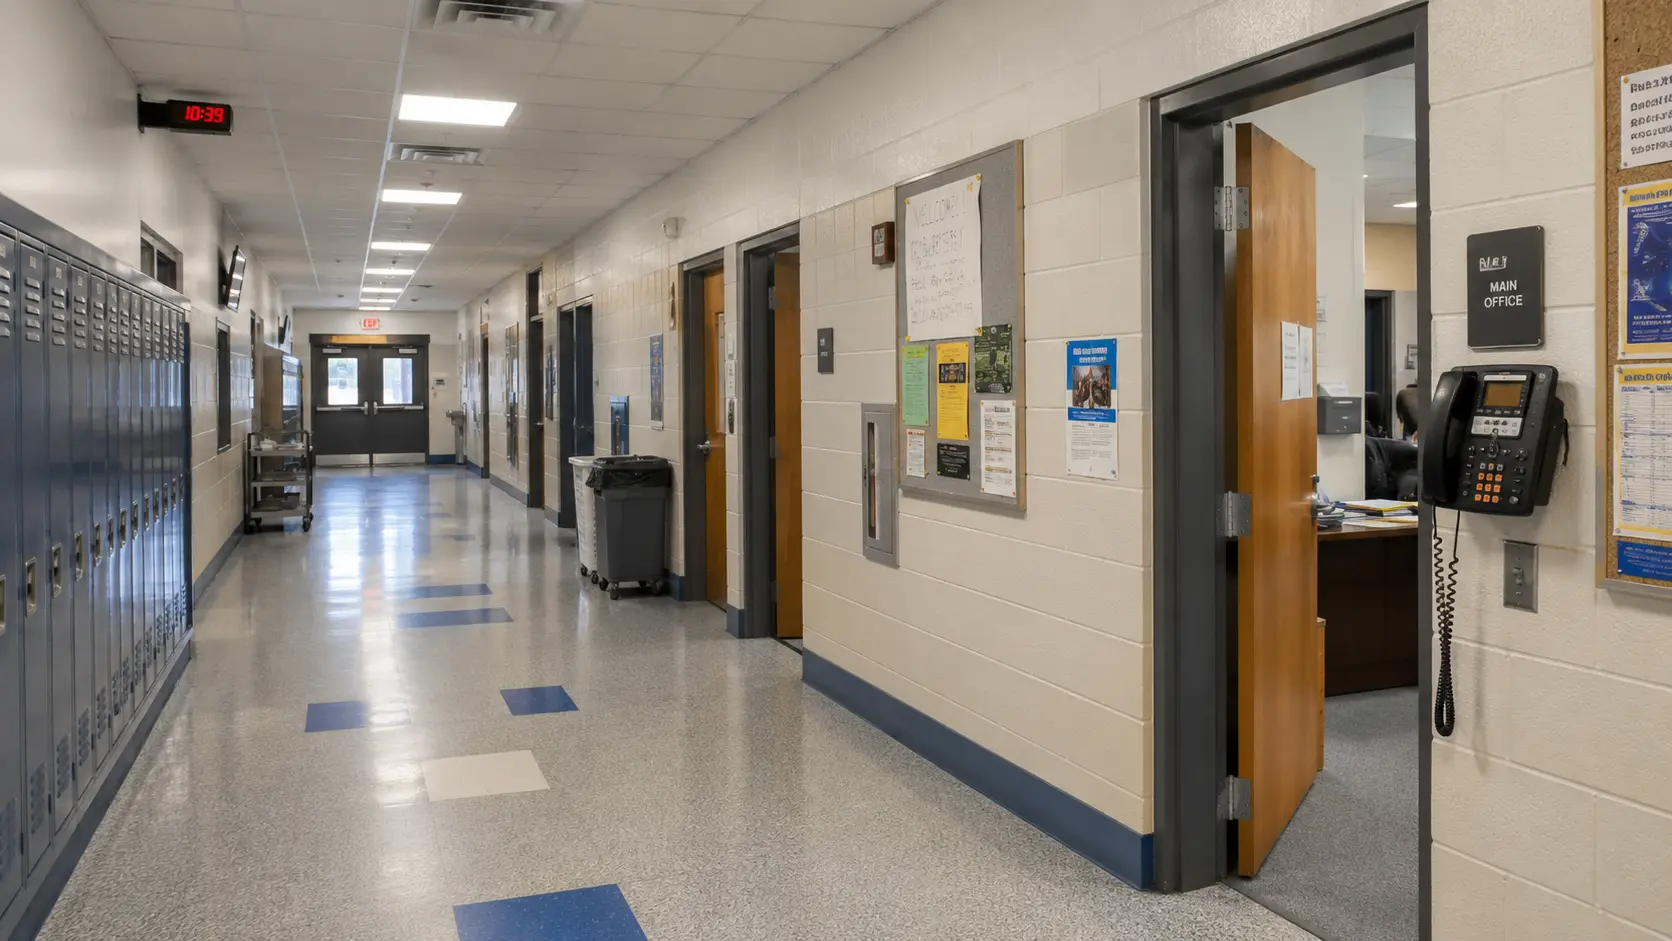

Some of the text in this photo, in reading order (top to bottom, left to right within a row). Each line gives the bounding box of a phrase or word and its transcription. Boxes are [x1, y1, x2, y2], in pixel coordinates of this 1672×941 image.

[185, 105, 225, 124] 10:39
[1489, 279, 1517, 293] MAIN
[1483, 294, 1523, 308] OFFICE
